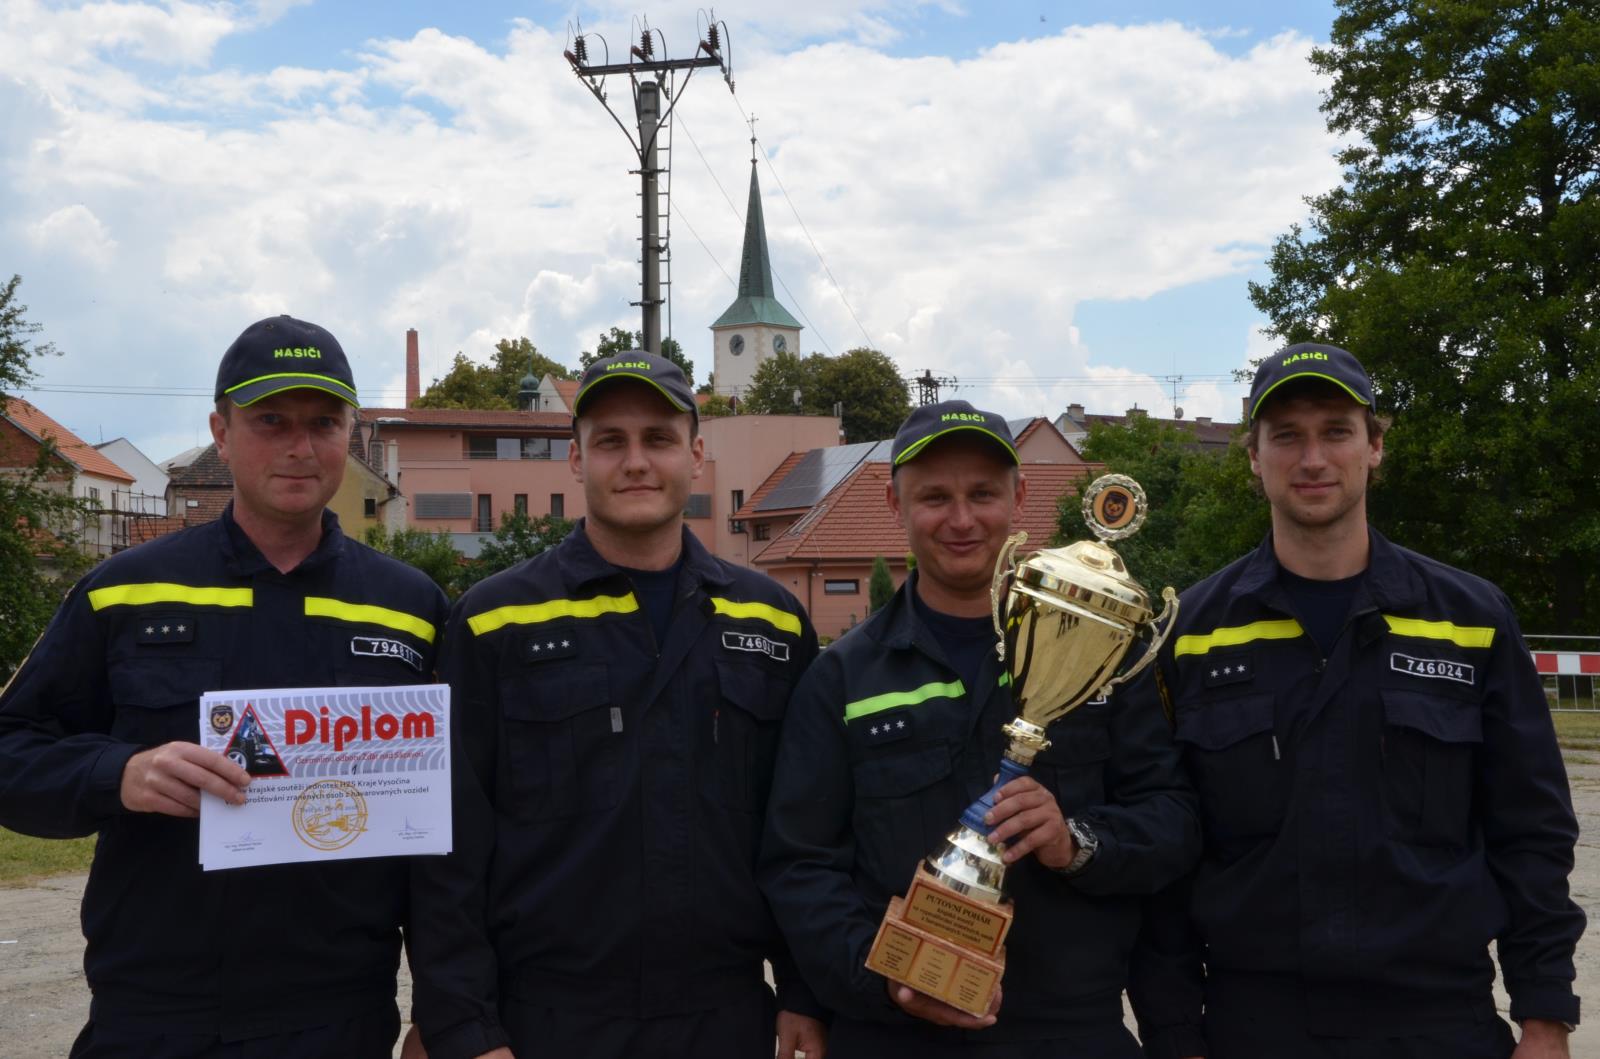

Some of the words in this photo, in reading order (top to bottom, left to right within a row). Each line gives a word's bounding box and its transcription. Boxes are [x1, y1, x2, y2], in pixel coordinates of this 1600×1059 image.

[274, 346, 321, 359] HASIČI
[1282, 351, 1328, 366] HASIČI
[941, 412, 985, 422] HASIČI
[1407, 659, 1463, 678] 746024
[285, 705, 435, 751] Diplom
[357, 779, 377, 788] Kraje
[378, 777, 410, 787] Vysočina
[326, 790, 344, 799] osob
[403, 785, 429, 794] vozidel
